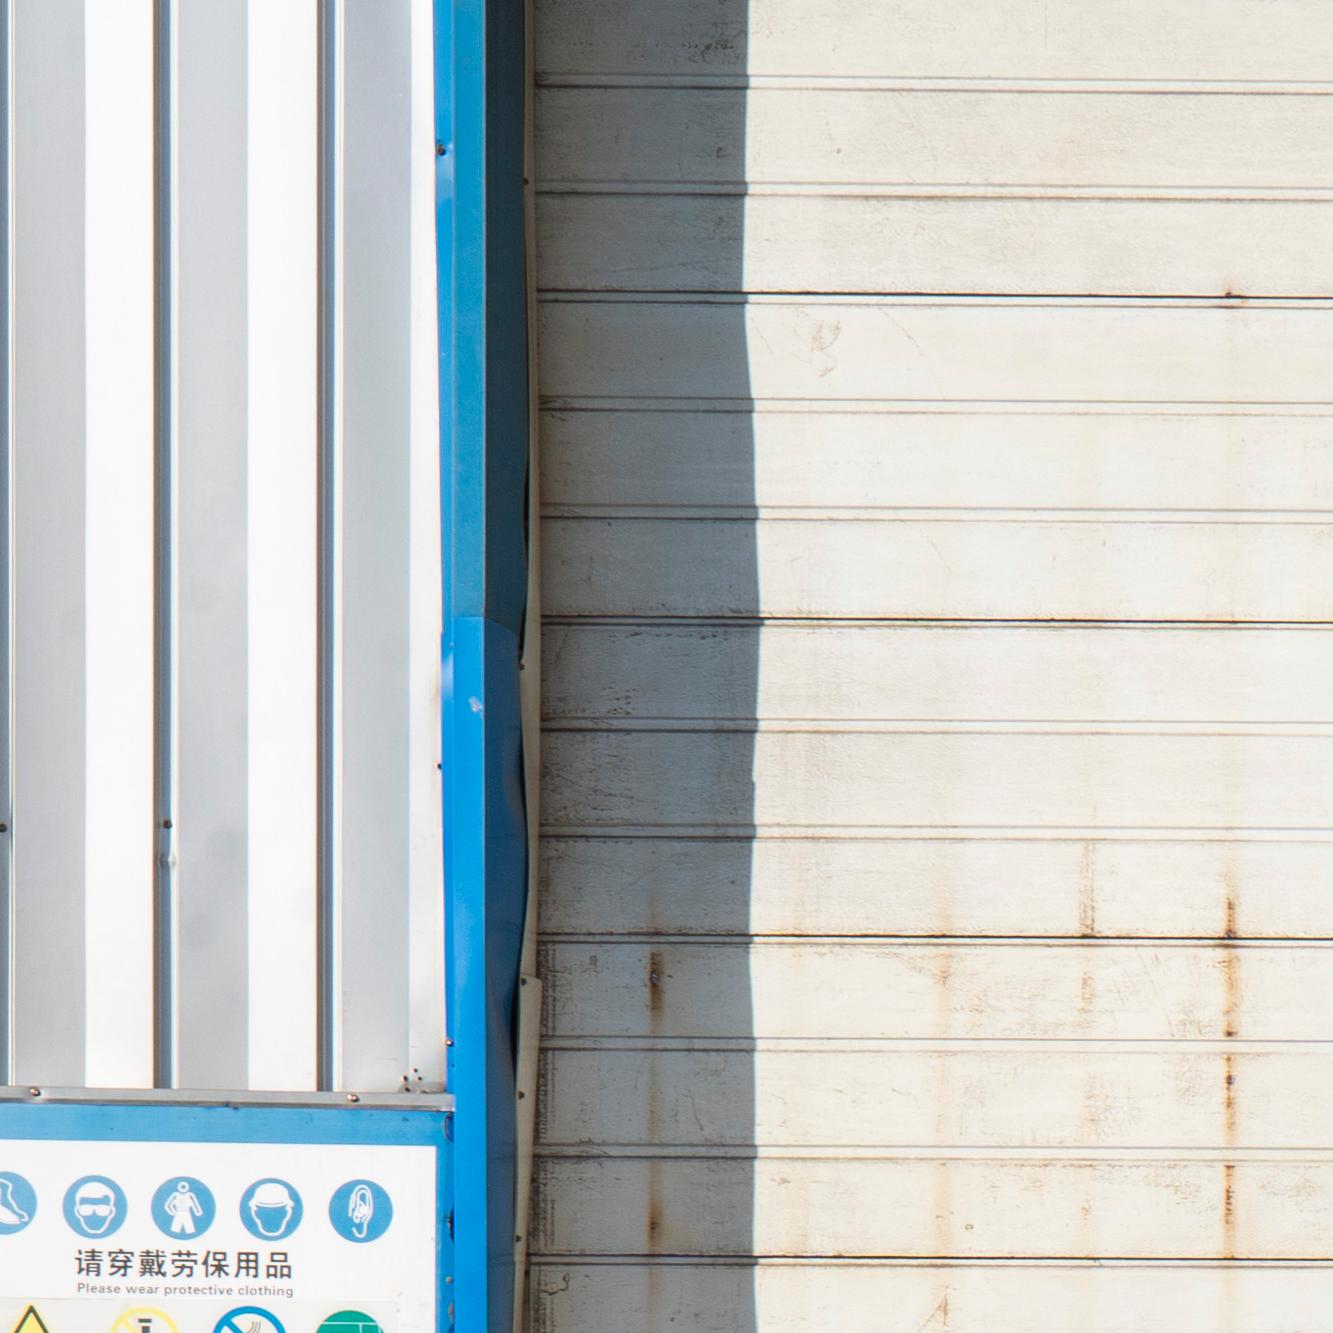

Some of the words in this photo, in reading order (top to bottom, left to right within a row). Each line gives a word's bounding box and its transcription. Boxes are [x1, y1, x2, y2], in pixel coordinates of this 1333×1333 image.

[75, 1249, 292, 1279] 请穿戴劳保用品
[77, 1282, 121, 1295] Please
[126, 1285, 160, 1295] wear
[164, 1284, 233, 1297] protective
[238, 1284, 294, 1299] clothing
